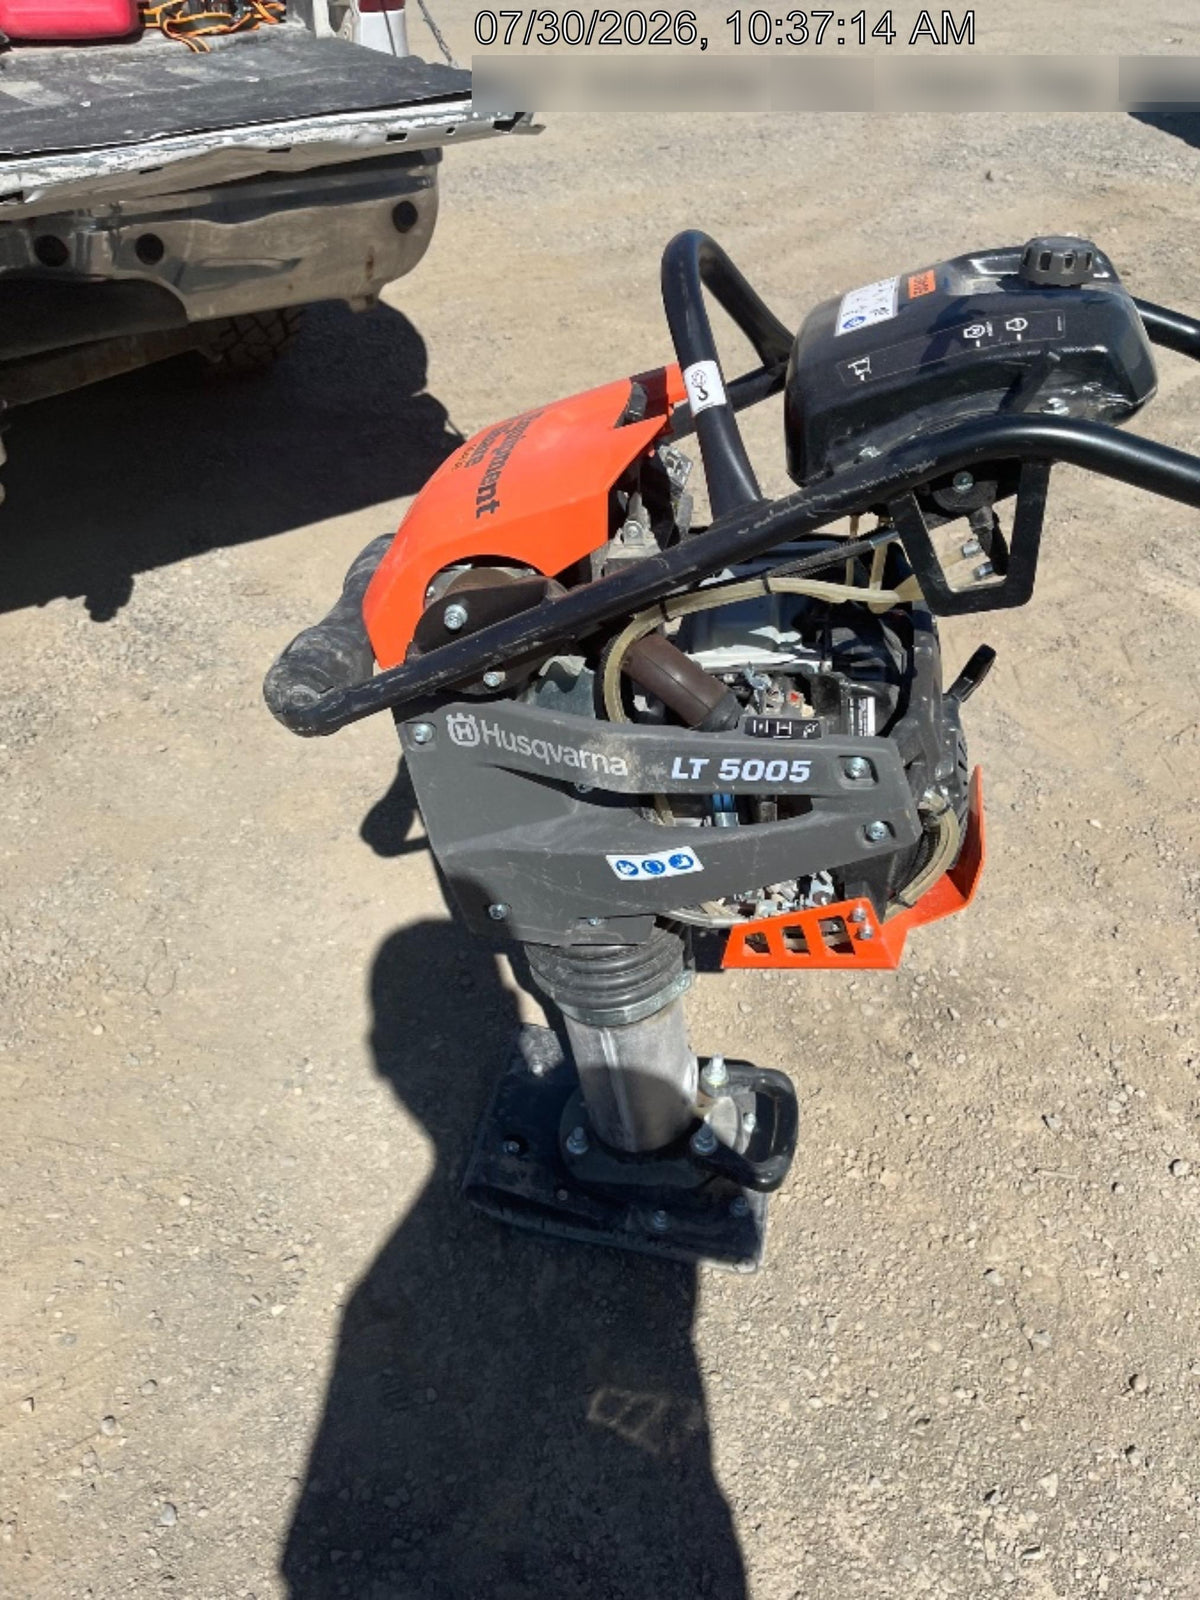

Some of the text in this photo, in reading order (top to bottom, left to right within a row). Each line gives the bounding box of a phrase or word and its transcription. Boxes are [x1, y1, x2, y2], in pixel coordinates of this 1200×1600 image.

[475, 408, 545, 519] ipment
[480, 719, 628, 776] Husqvarna
[671, 757, 812, 783] LT 5005
